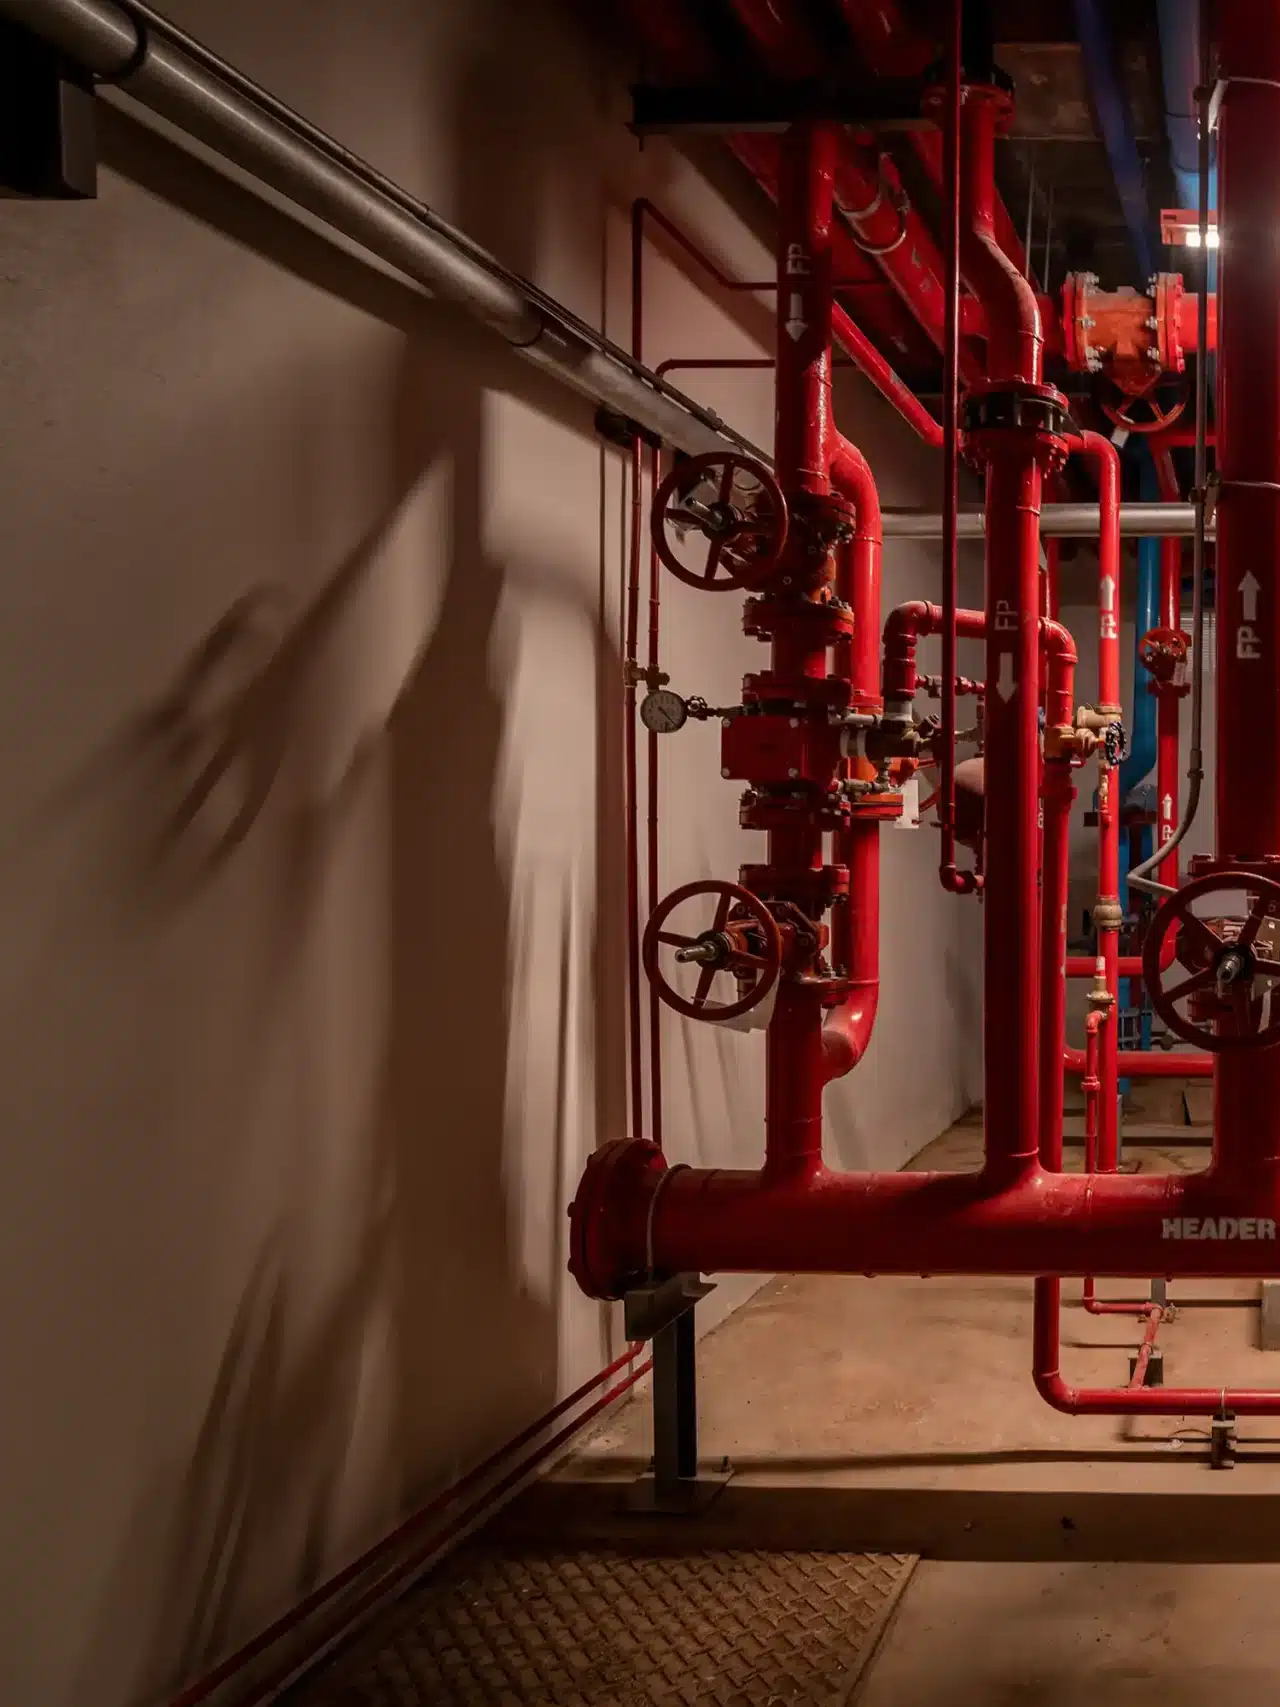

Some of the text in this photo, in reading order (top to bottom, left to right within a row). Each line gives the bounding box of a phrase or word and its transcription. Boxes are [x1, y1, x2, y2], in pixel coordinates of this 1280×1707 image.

[787, 243, 810, 273] FP
[995, 600, 1018, 630] FP
[1101, 614, 1117, 639] FP
[1236, 626, 1261, 659] FP
[1162, 1218, 1276, 1240] HEADER
